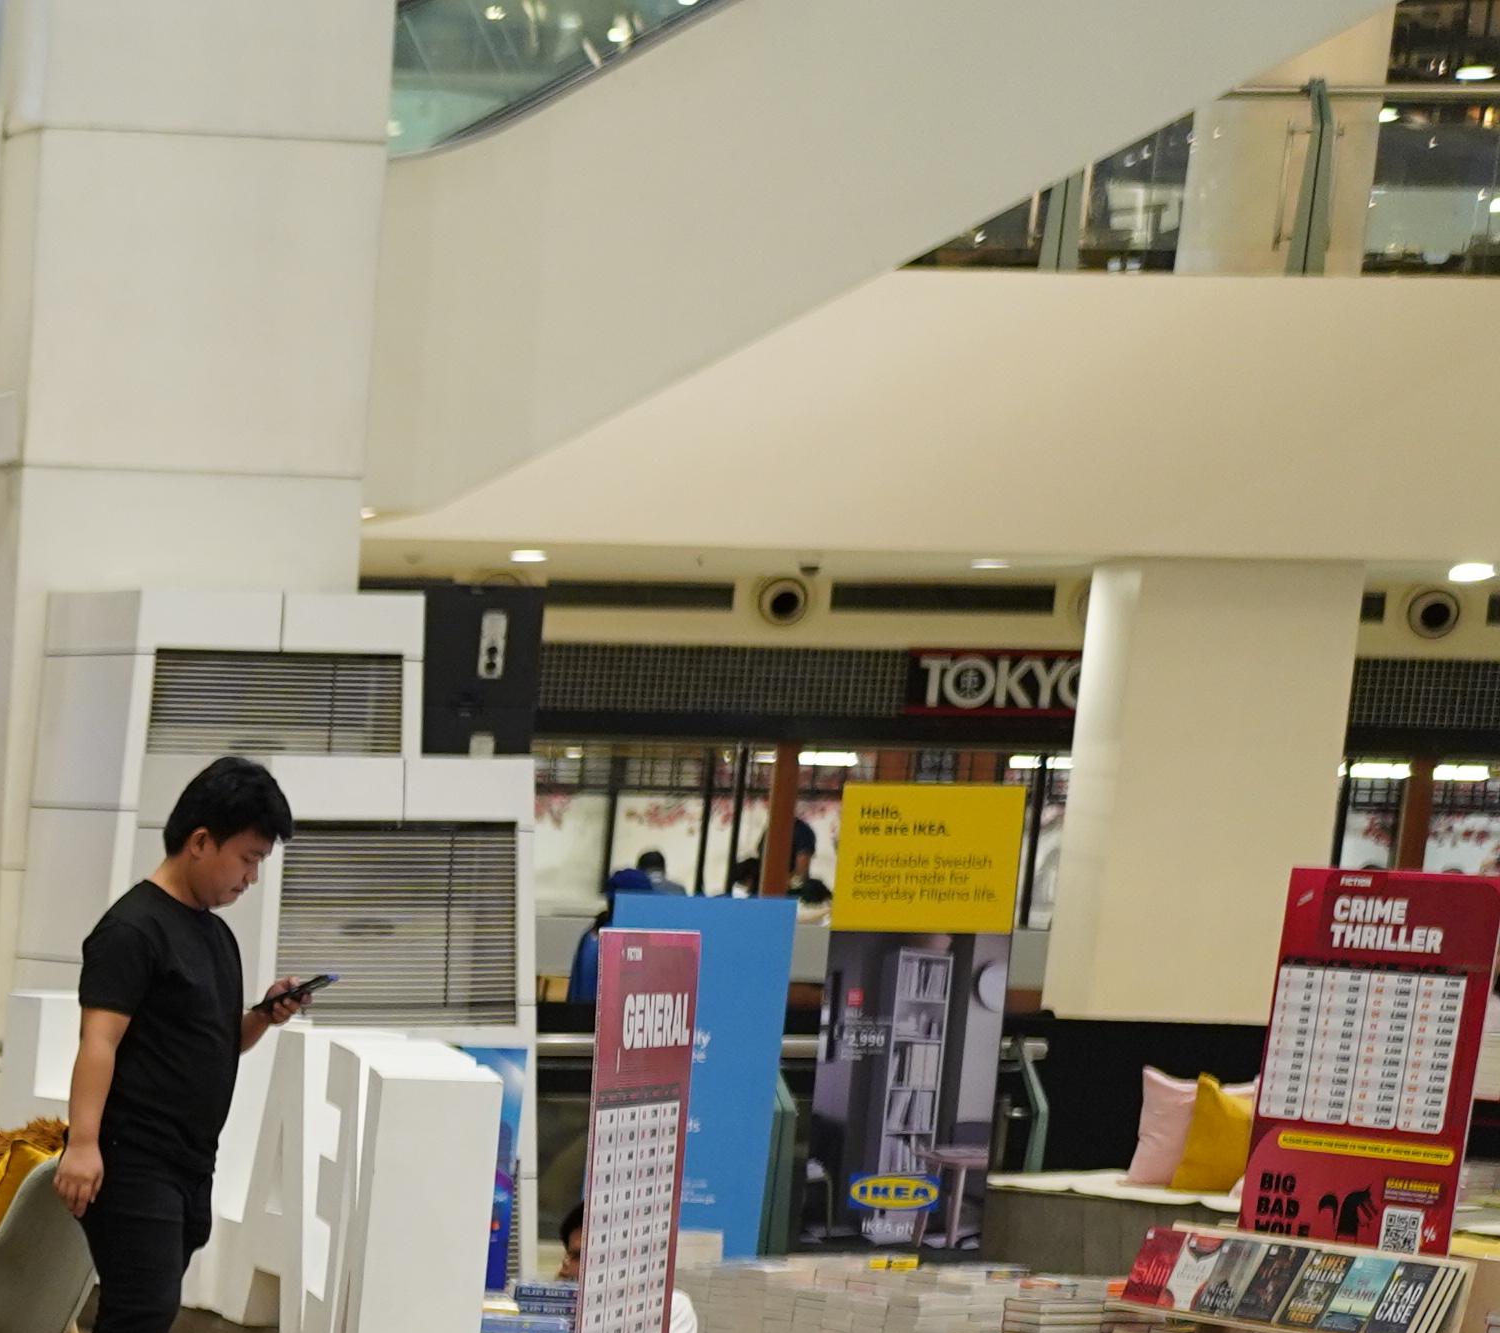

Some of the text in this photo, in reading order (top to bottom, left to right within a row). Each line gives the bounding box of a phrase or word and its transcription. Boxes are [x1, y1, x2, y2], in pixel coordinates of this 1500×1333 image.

[861, 805, 902, 822] Hello,
[1339, 875, 1373, 887] FICTION
[1333, 896, 1409, 924] CRIME
[1330, 923, 1444, 954] THRILLER
[621, 992, 690, 1051] GENERAL
[859, 1186, 931, 1199] IKEA
[1260, 1173, 1296, 1194] BIG
[1256, 1196, 1300, 1219] BAD
[1386, 1281, 1424, 1302] HEAD
[1375, 1301, 1414, 1325] CASE
